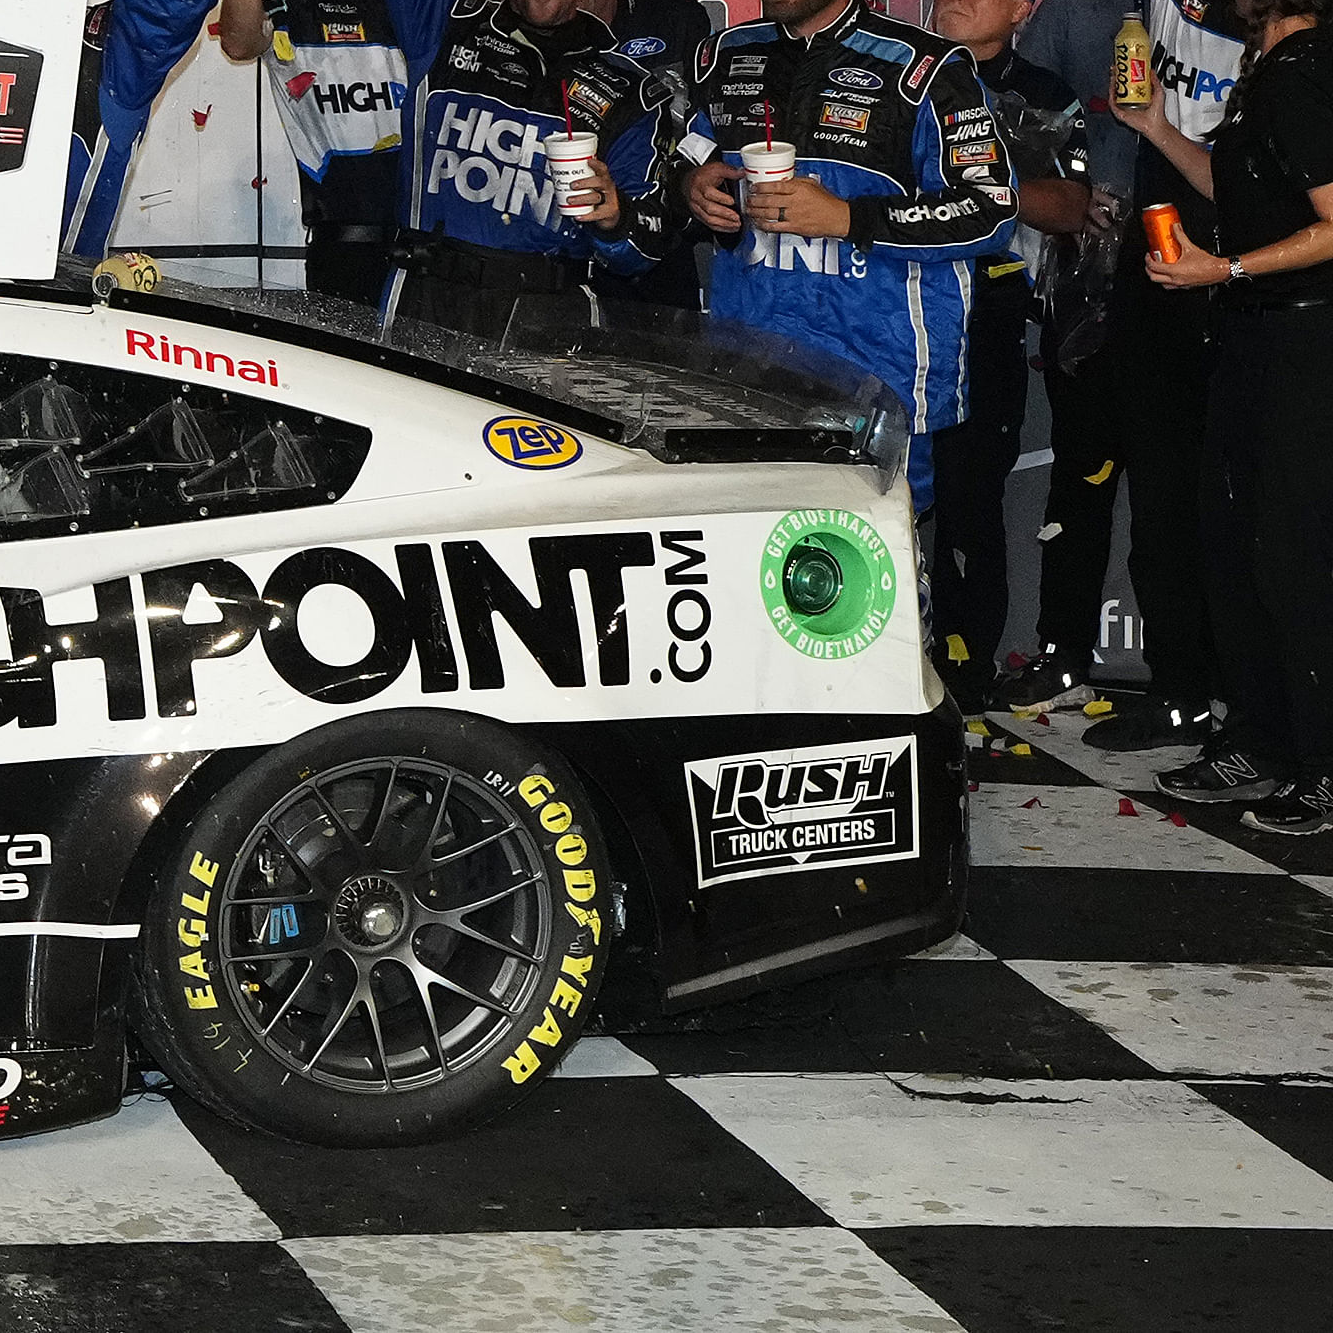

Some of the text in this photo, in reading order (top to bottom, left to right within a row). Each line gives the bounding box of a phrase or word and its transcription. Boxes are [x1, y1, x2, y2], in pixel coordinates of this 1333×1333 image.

[836, 68, 872, 87] Ford
[908, 54, 934, 88] SIMPSON
[1114, 42, 1128, 98] Coors
[945, 119, 992, 142] HAAS
[125, 328, 279, 390] Rinnai
[494, 423, 568, 461] Zep
[767, 509, 886, 561] GET BIOETHANOL
[649, 530, 712, 685] .COM
[771, 605, 890, 659] GET BIOETHANOL
[711, 751, 891, 830] RUSH
[729, 818, 876, 856] TRUCK CENTERS
[177, 851, 220, 1010] EAGLE
